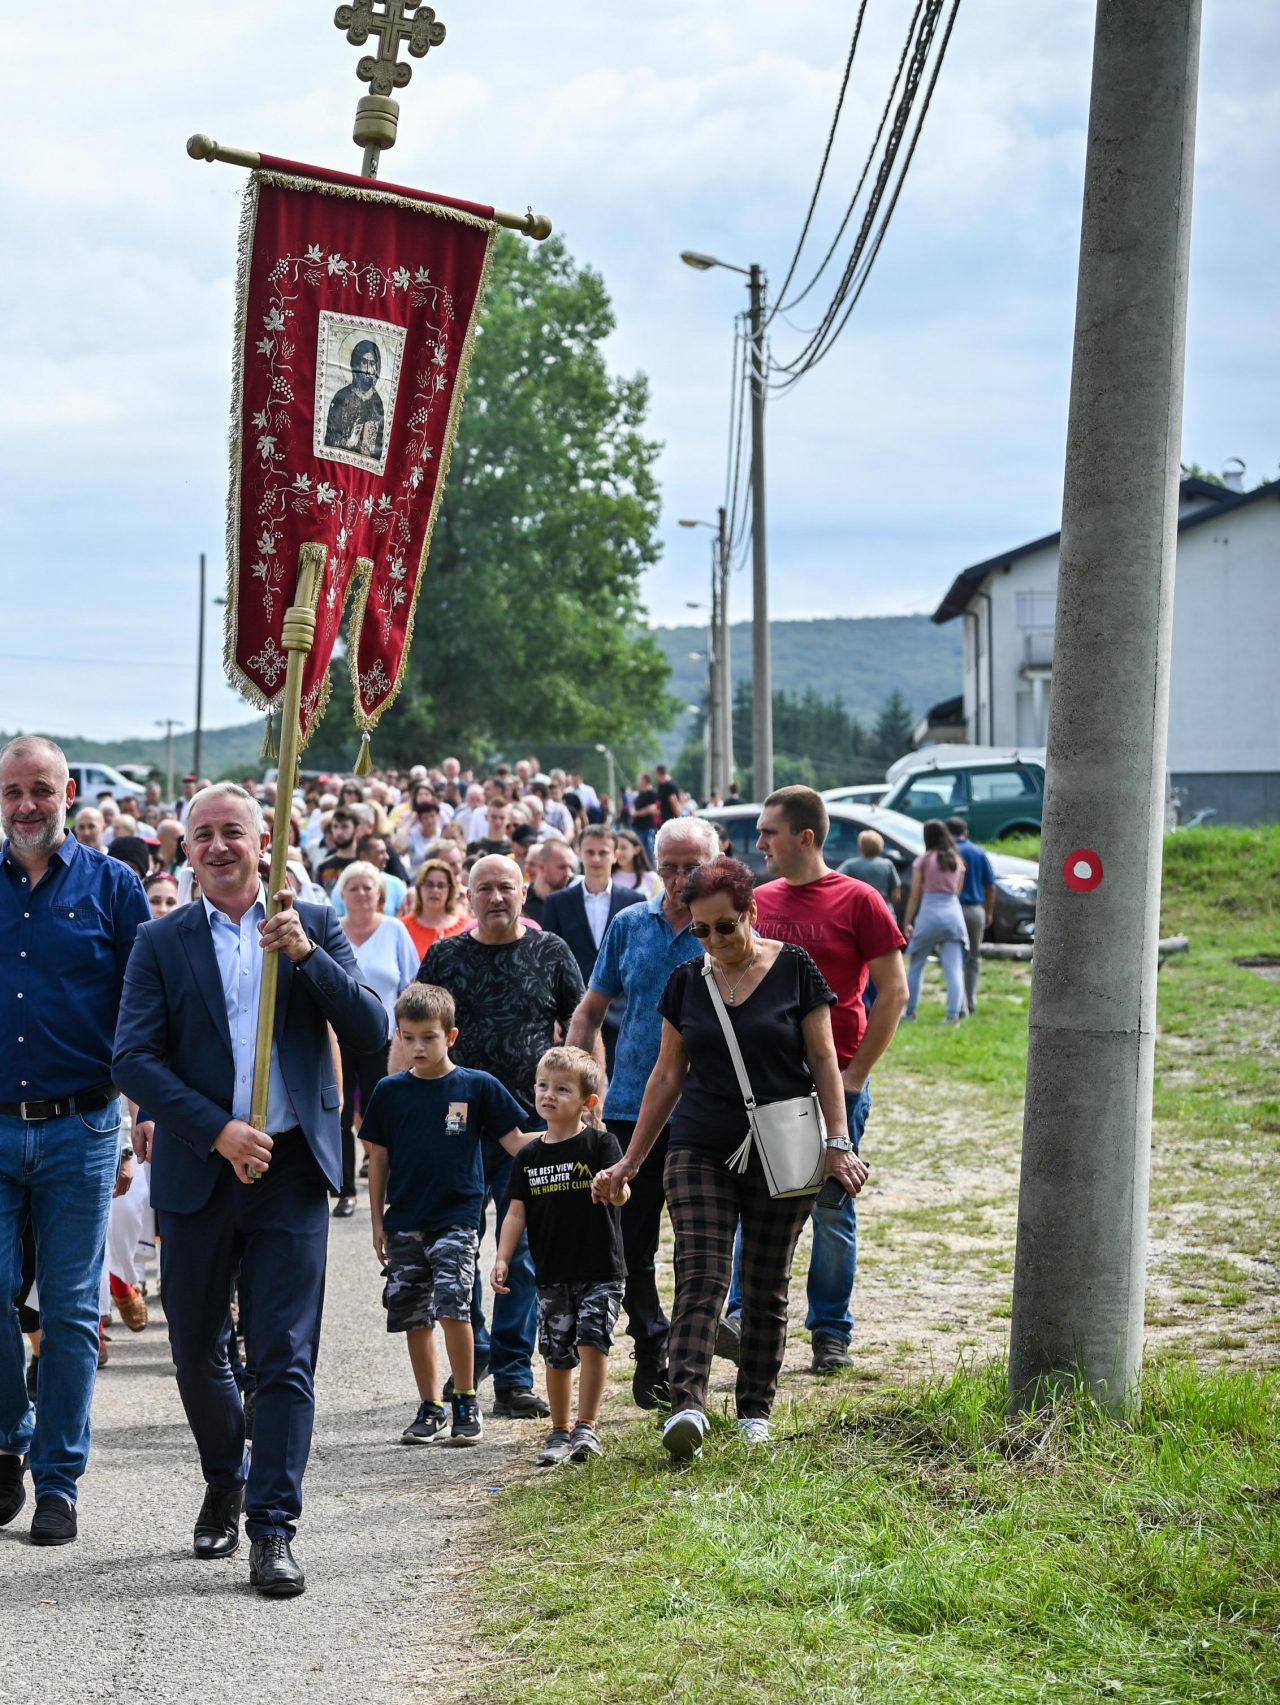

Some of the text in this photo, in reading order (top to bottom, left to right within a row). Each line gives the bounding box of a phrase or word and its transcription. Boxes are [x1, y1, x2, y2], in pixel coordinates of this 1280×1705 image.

[528, 1162, 573, 1177] THE BEST VIEW
[529, 1172, 570, 1186] COMES AFTER
[530, 1187, 541, 1196] THE
[542, 1182, 570, 1193] HARDEST
